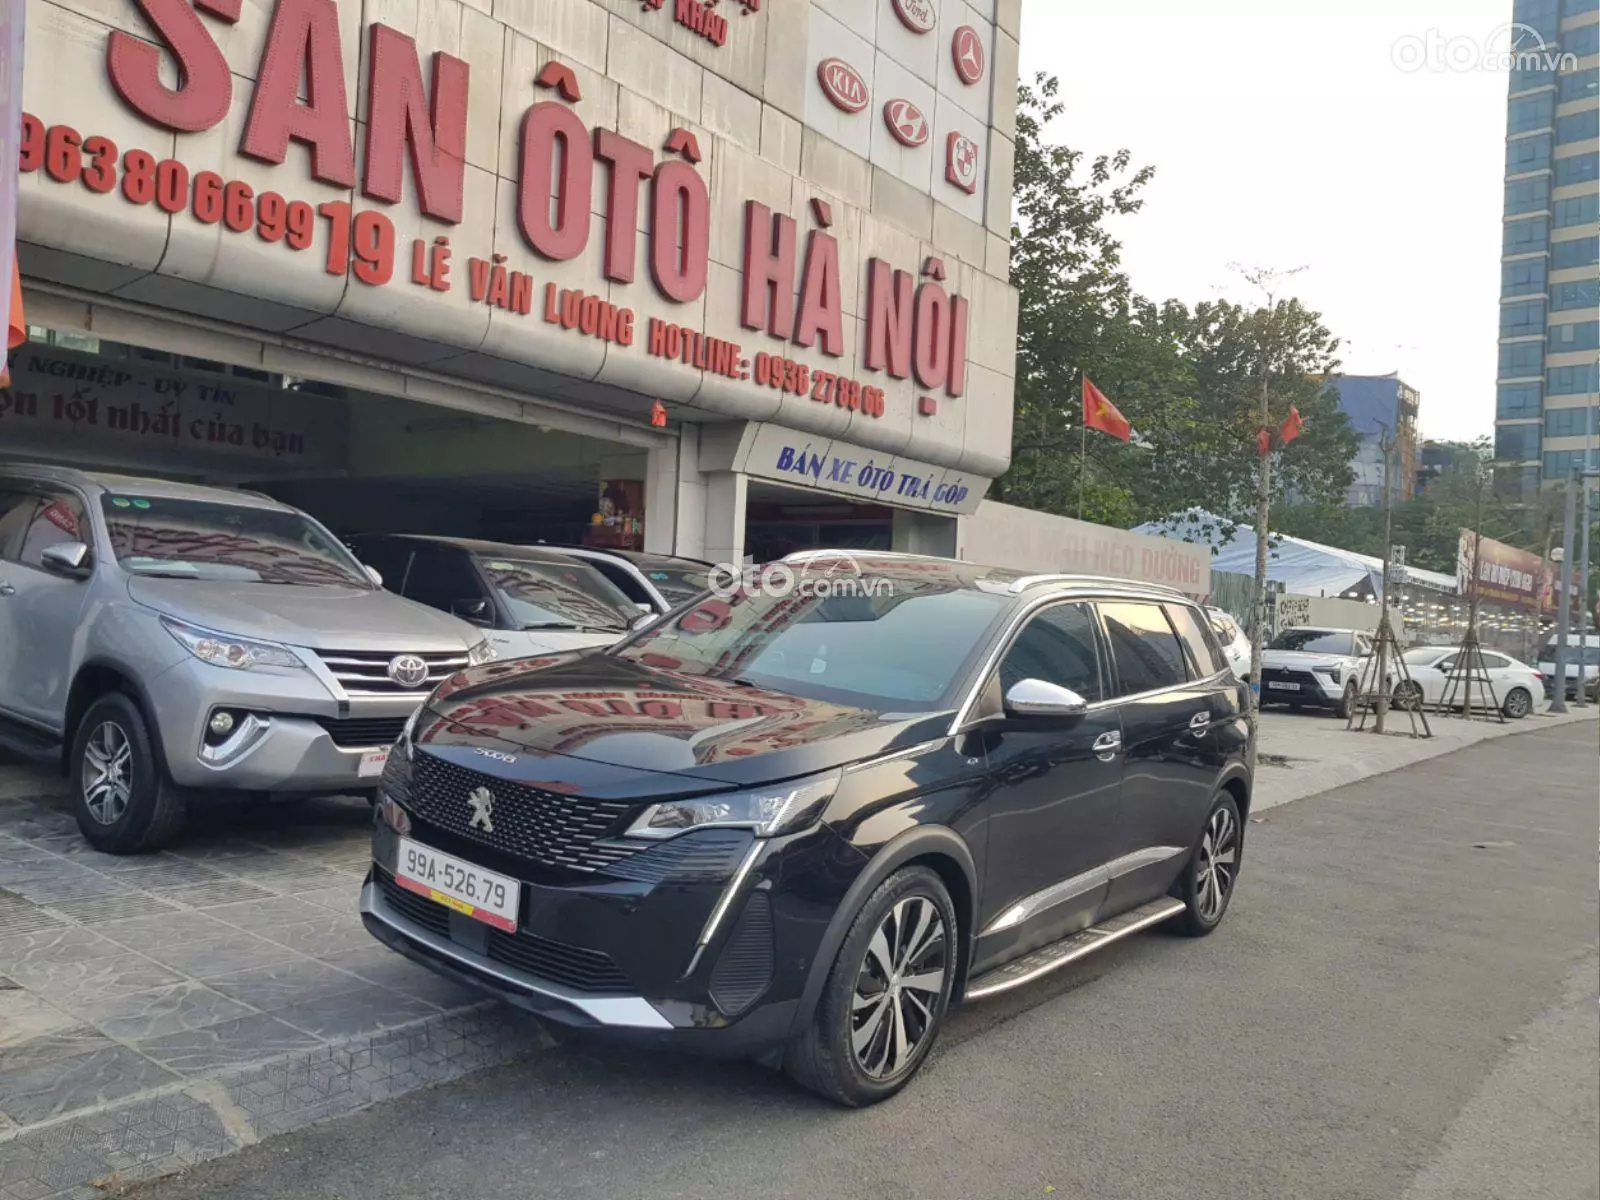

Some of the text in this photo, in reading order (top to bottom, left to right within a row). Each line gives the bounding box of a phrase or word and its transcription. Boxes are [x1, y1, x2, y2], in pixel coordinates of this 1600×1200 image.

[832, 66, 862, 103] KIA
[517, 61, 710, 303] ÔTÔ
[740, 198, 844, 357] HÀ
[865, 256, 969, 416] NỘI
[411, 236, 451, 292] LÊ
[468, 253, 533, 315] VĂN
[648, 317, 750, 380] HOTLINE:
[776, 443, 826, 479] BÁN
[826, 457, 857, 484] XE
[858, 459, 895, 492] ÔTÔ
[932, 478, 969, 506] GÓP
[407, 849, 506, 909] 99A-526.79
